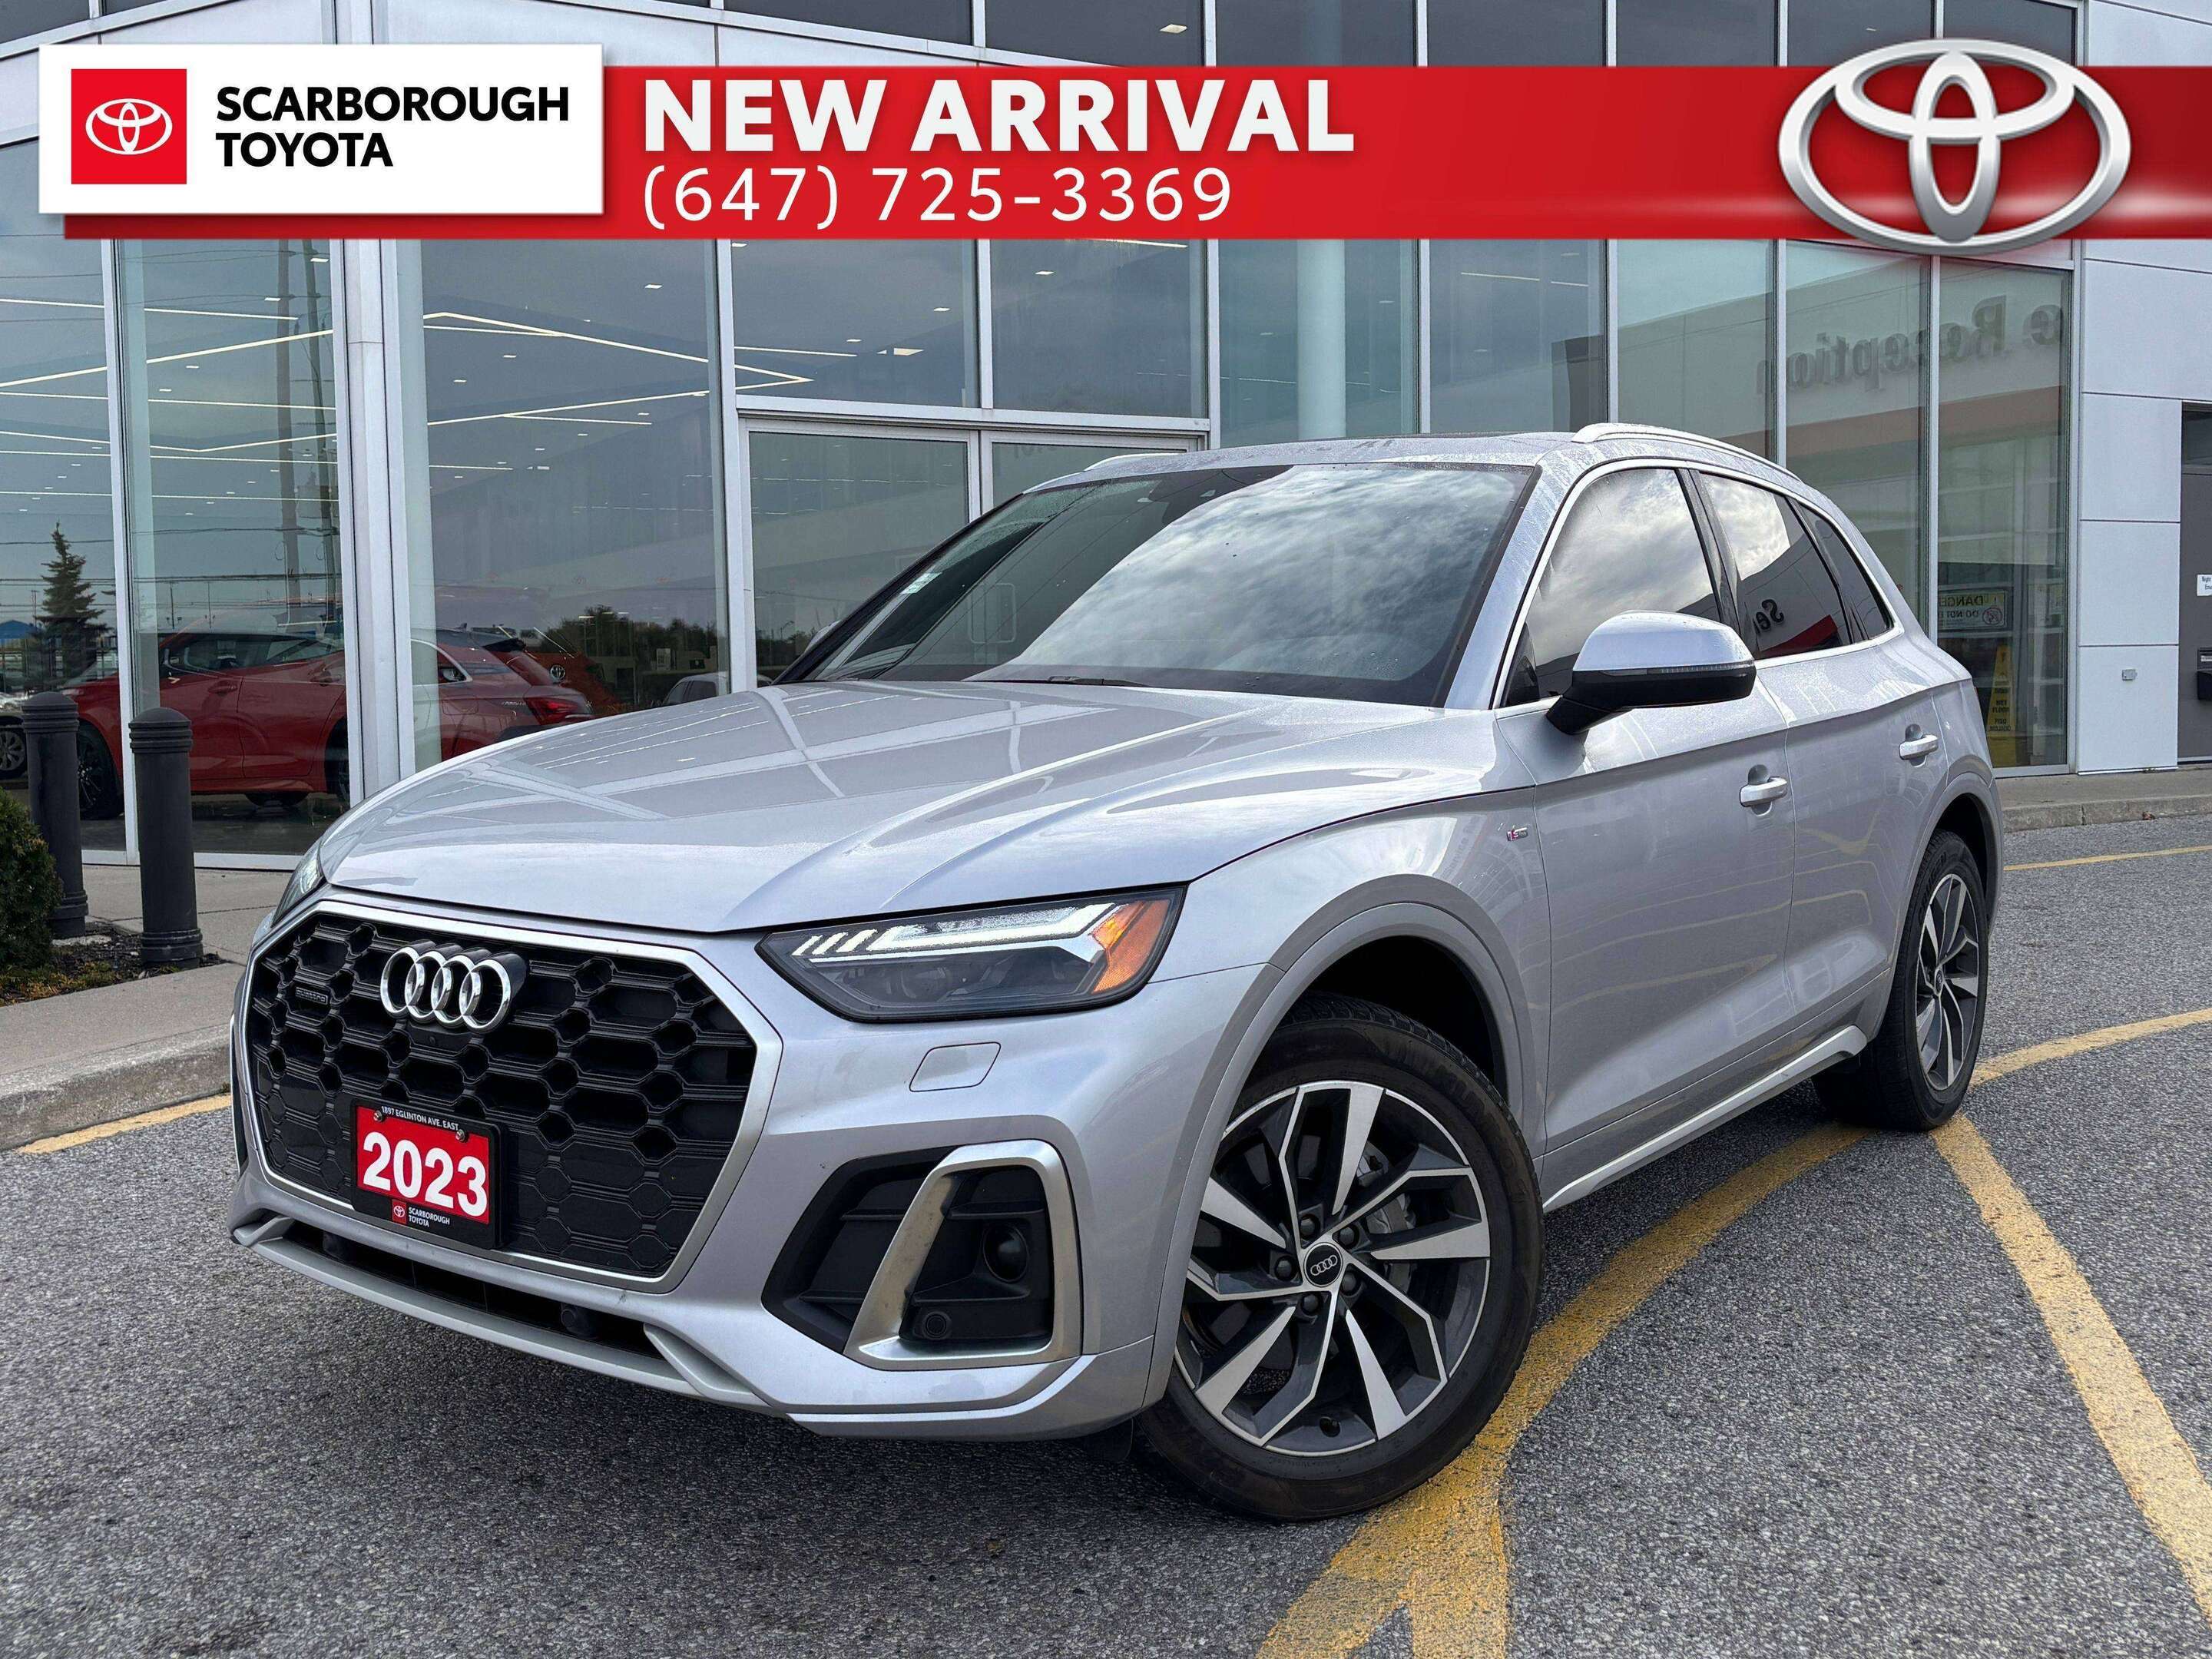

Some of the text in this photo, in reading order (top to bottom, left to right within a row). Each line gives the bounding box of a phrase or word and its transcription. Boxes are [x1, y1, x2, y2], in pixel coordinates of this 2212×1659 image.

[381, 1105, 395, 1115] 1897
[396, 1109, 427, 1124] EGLINTON
[443, 1120, 459, 1131] EAST
[363, 1131, 488, 1217] 2023
[409, 1207, 450, 1225] SCARBOROUGH
[409, 1215, 430, 1227] TOYOTA
